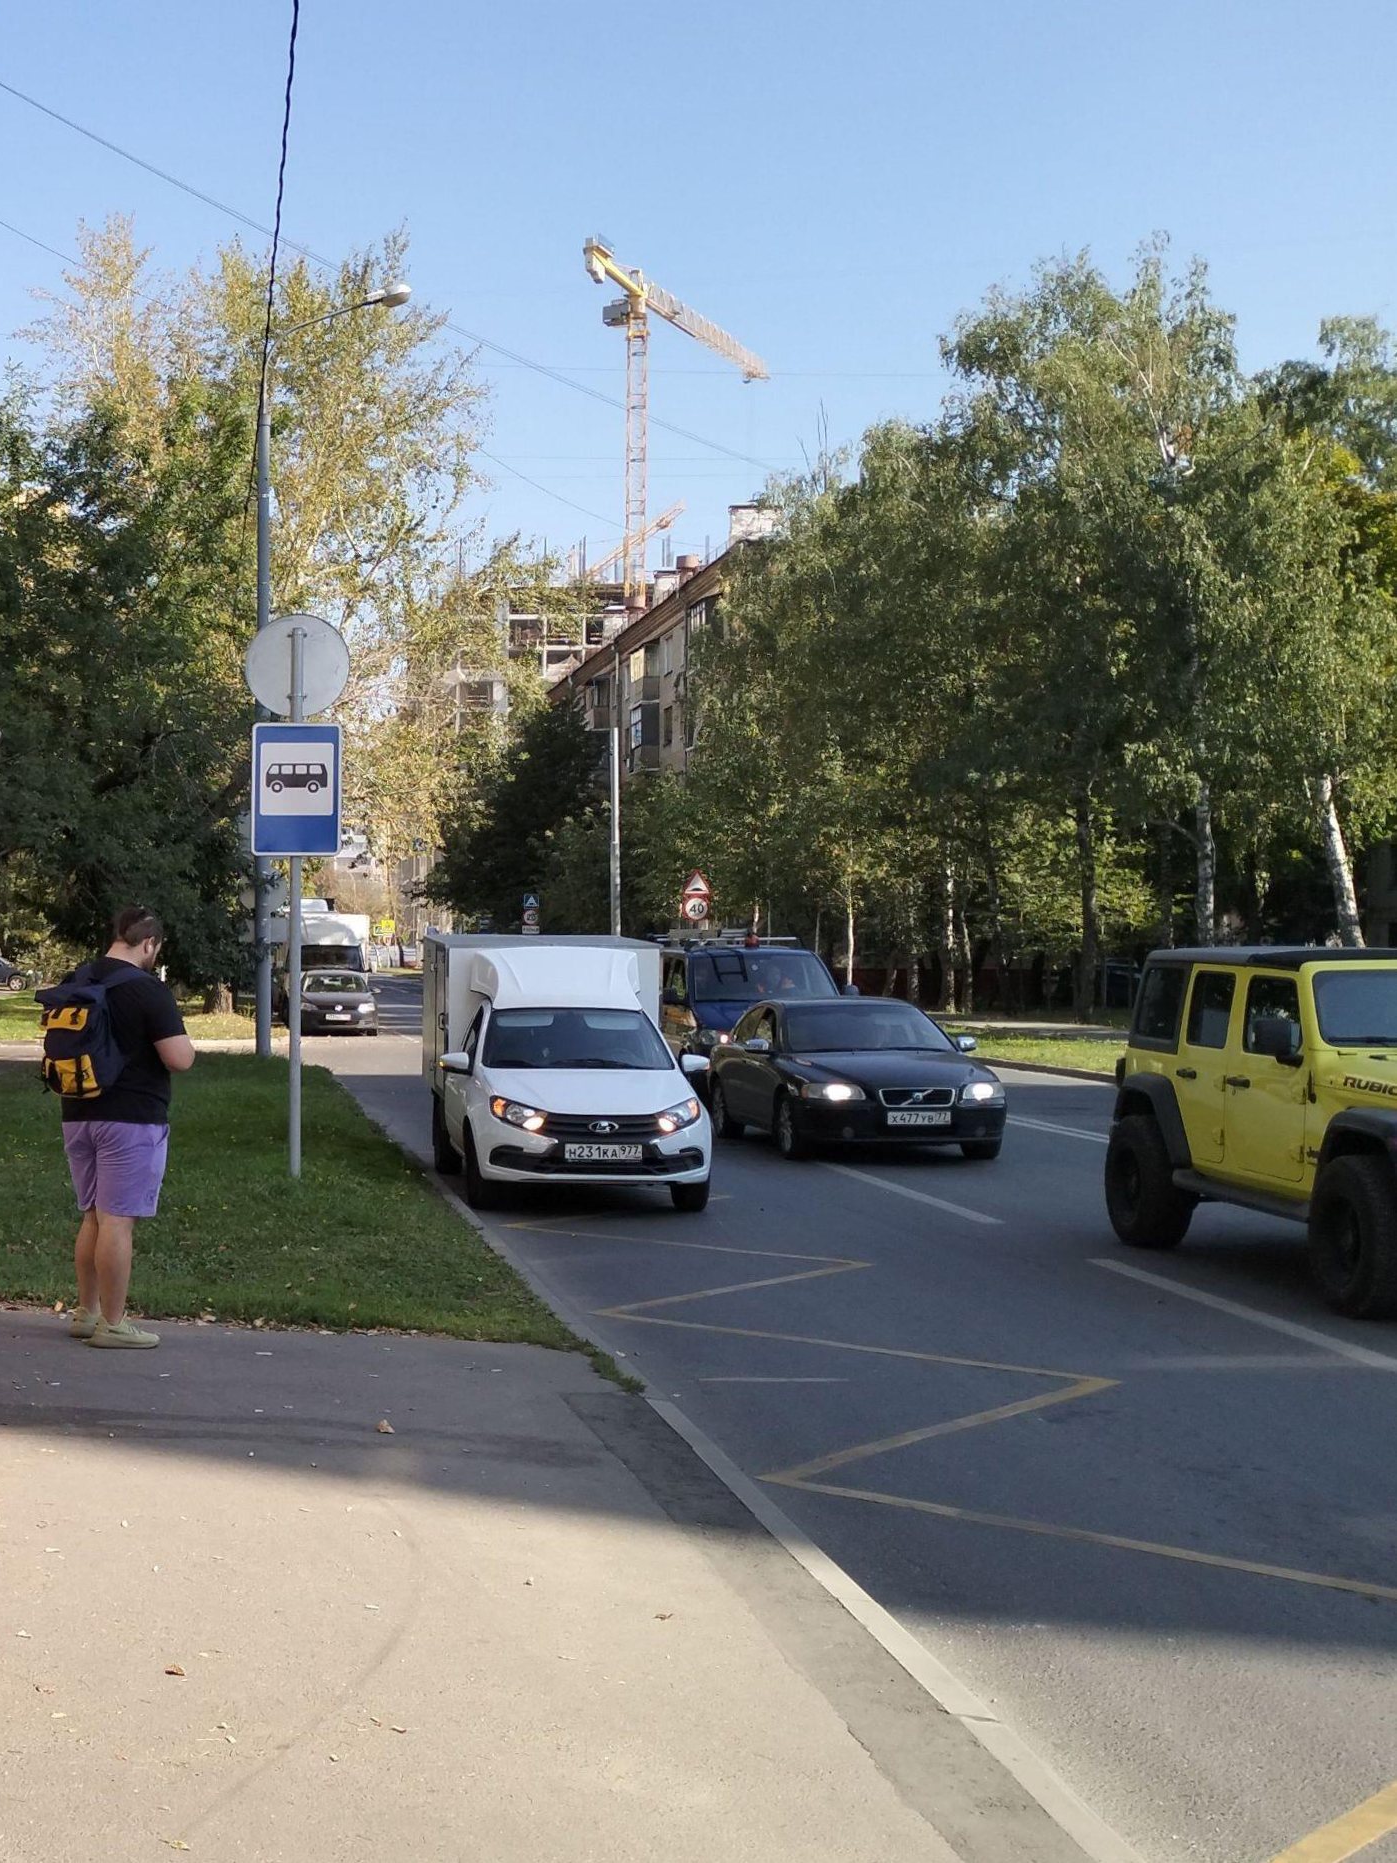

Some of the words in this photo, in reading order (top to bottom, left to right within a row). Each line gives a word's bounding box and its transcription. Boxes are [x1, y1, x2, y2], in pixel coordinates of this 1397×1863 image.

[689, 903, 704, 914] 40
[569, 1146, 618, 1158] Н231КА
[621, 1145, 639, 1154] 977
